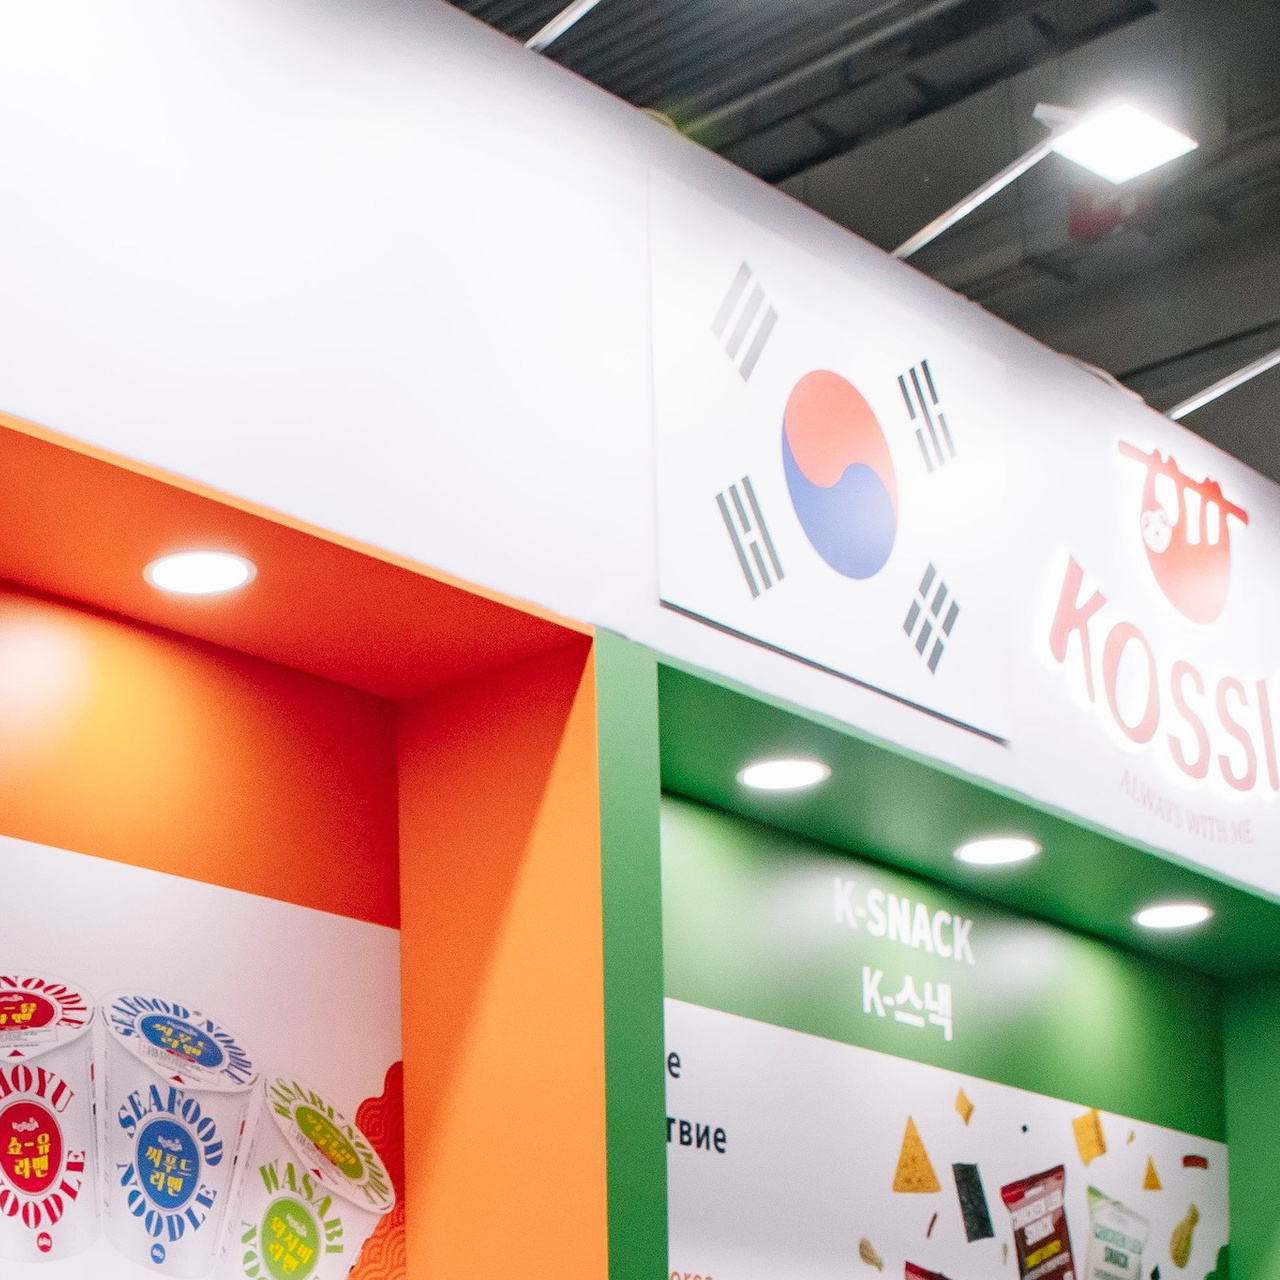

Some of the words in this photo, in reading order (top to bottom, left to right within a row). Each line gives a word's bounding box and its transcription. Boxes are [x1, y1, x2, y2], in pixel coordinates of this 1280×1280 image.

[1049, 554, 1279, 792] KOSSI
[1187, 812, 1228, 842] WITH
[833, 877, 975, 965] K-SNACK
[111, 996, 190, 1038] SEAFOOD
[862, 966, 953, 1042] K-스낵
[118, 1084, 223, 1167] SEAFOOD
[116, 1162, 217, 1242] NOODLE
[259, 1158, 344, 1254] WASABI
